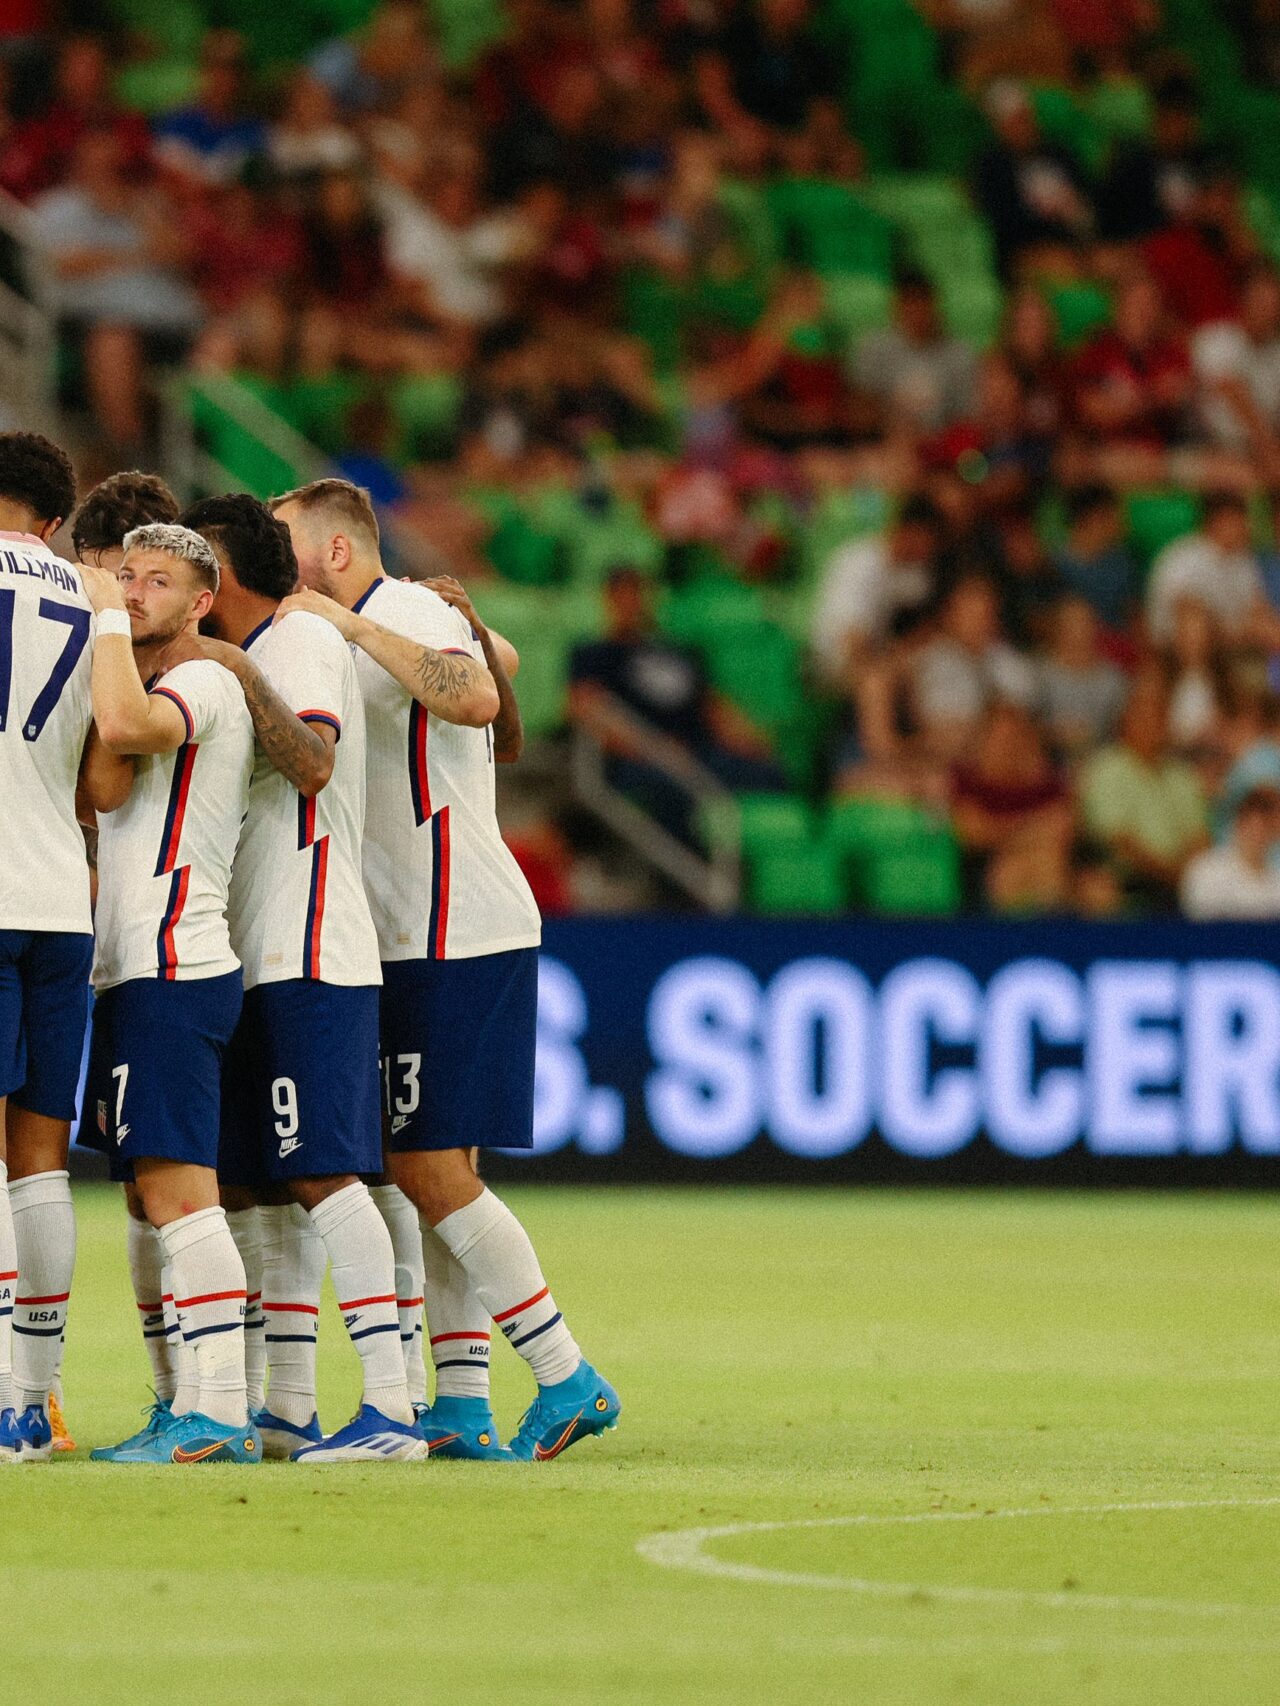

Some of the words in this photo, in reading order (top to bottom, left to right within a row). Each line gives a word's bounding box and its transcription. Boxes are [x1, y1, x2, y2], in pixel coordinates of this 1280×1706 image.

[647, 956, 1280, 1156] SOCCER
[112, 1064, 129, 1126] 7
[272, 1077, 299, 1137] 9
[281, 1137, 298, 1150] NIKE
[28, 1311, 58, 1322] USA
[469, 1346, 488, 1356] USA
